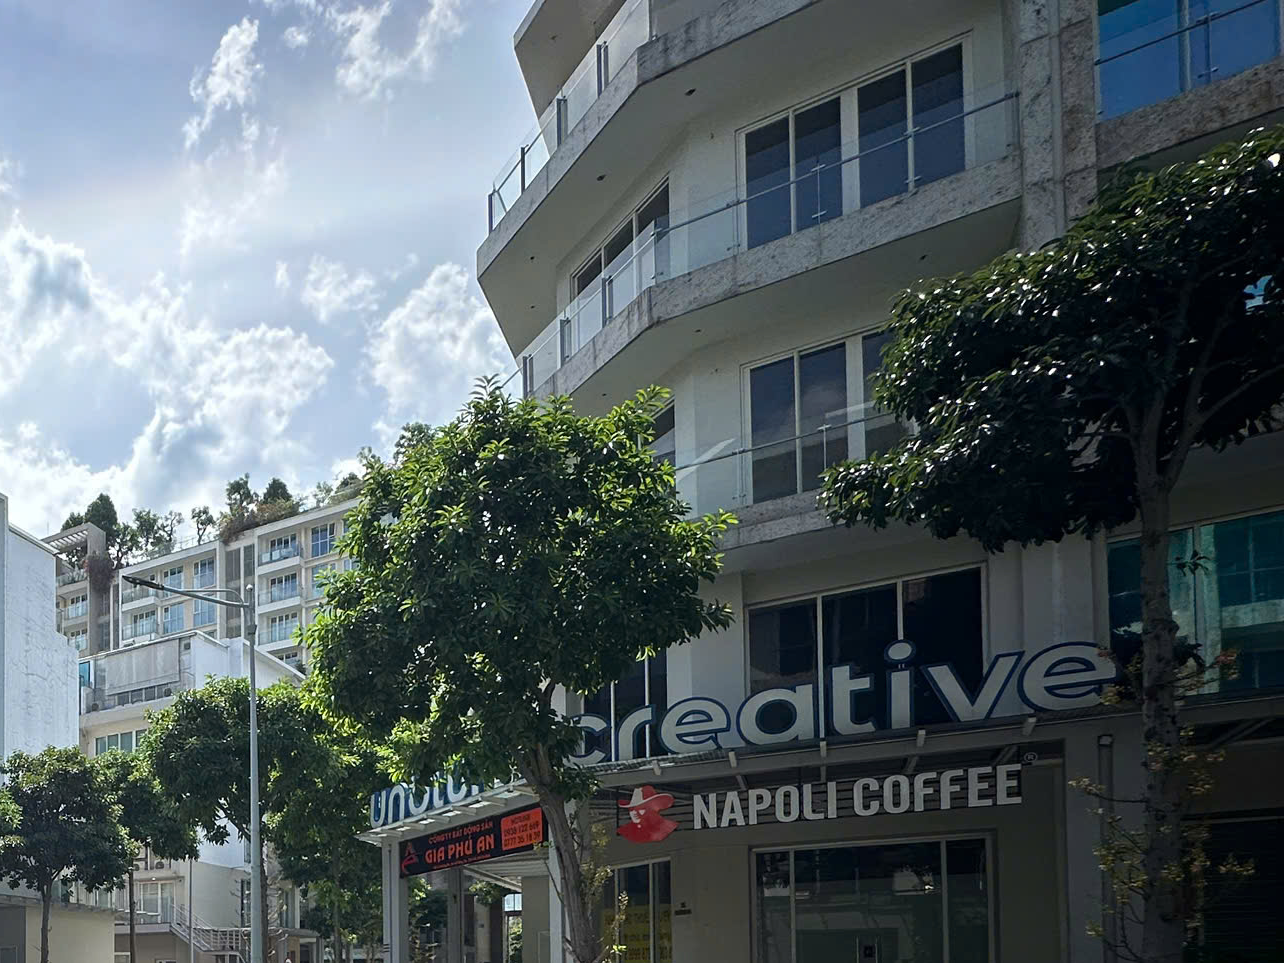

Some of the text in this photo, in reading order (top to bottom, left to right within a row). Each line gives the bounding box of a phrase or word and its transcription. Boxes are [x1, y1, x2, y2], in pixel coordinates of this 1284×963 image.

[564, 639, 1118, 768] creative
[693, 782, 838, 830] NAPOLI
[853, 764, 1022, 817] COFFEE
[425, 846, 445, 864] GIA
[476, 833, 495, 854] AN
